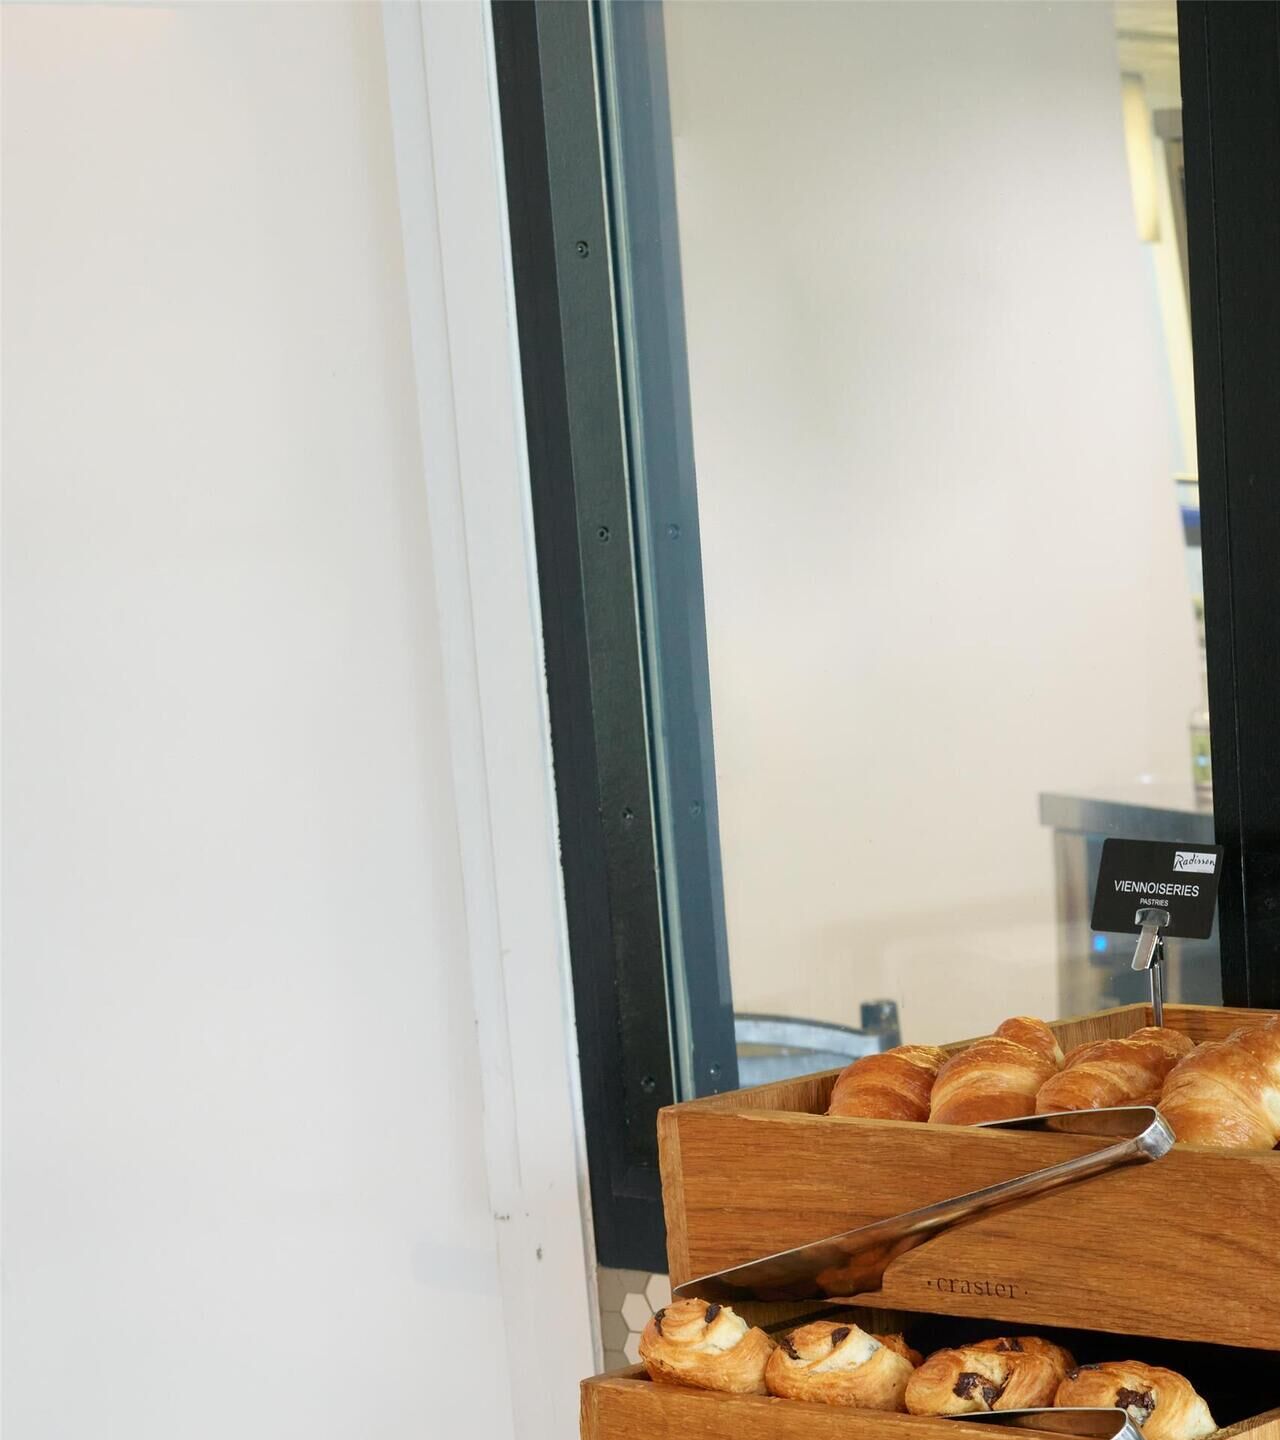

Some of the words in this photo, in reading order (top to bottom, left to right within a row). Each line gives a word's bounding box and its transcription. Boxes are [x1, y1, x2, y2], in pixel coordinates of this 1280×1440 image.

[1173, 853, 1217, 870] Radisson
[1114, 880, 1200, 897] VIENNOISERIES
[1140, 898, 1169, 907] PASTRIES
[937, 1277, 1019, 1299] craster
